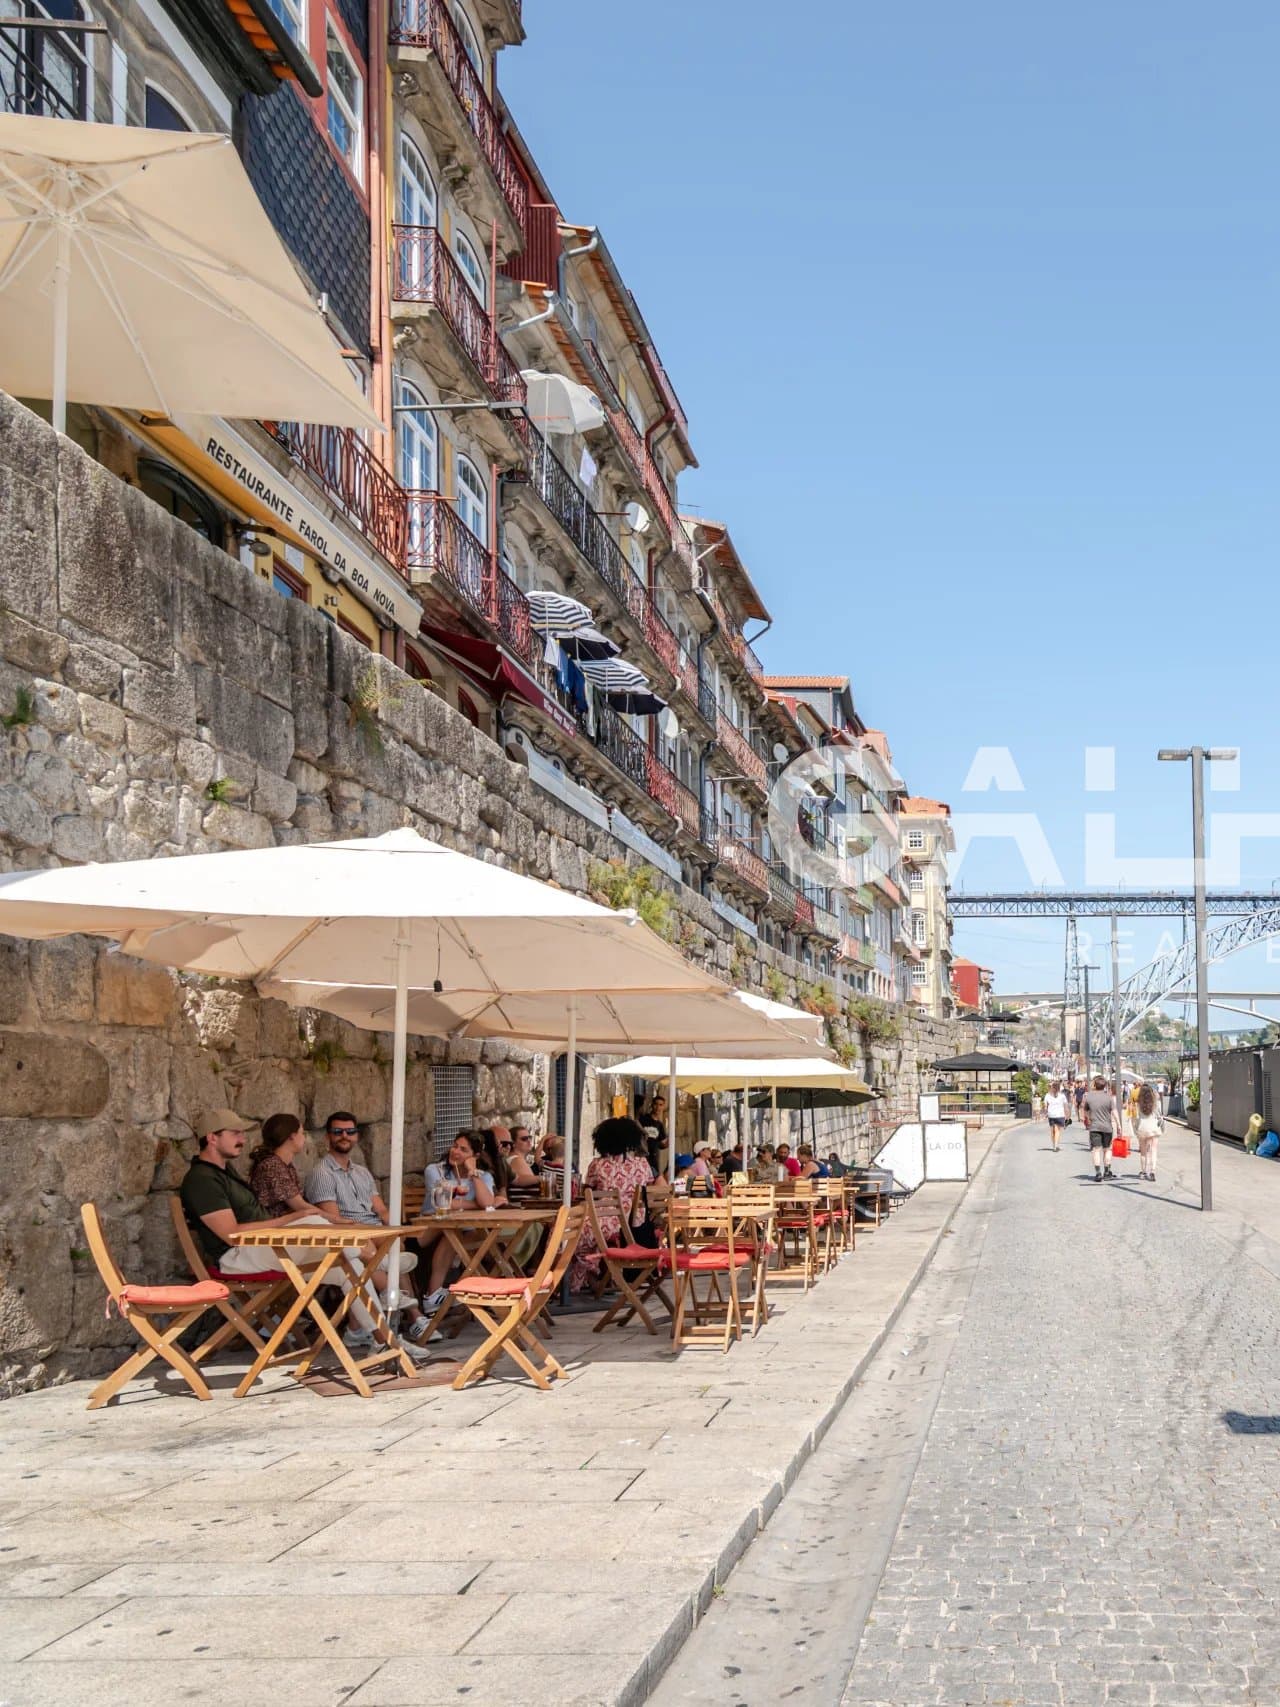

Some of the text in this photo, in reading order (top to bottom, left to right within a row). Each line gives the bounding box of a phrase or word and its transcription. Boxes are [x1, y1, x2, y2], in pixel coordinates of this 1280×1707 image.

[206, 437, 395, 616] RESTAURANTE FAROL DA BOA NOVA
